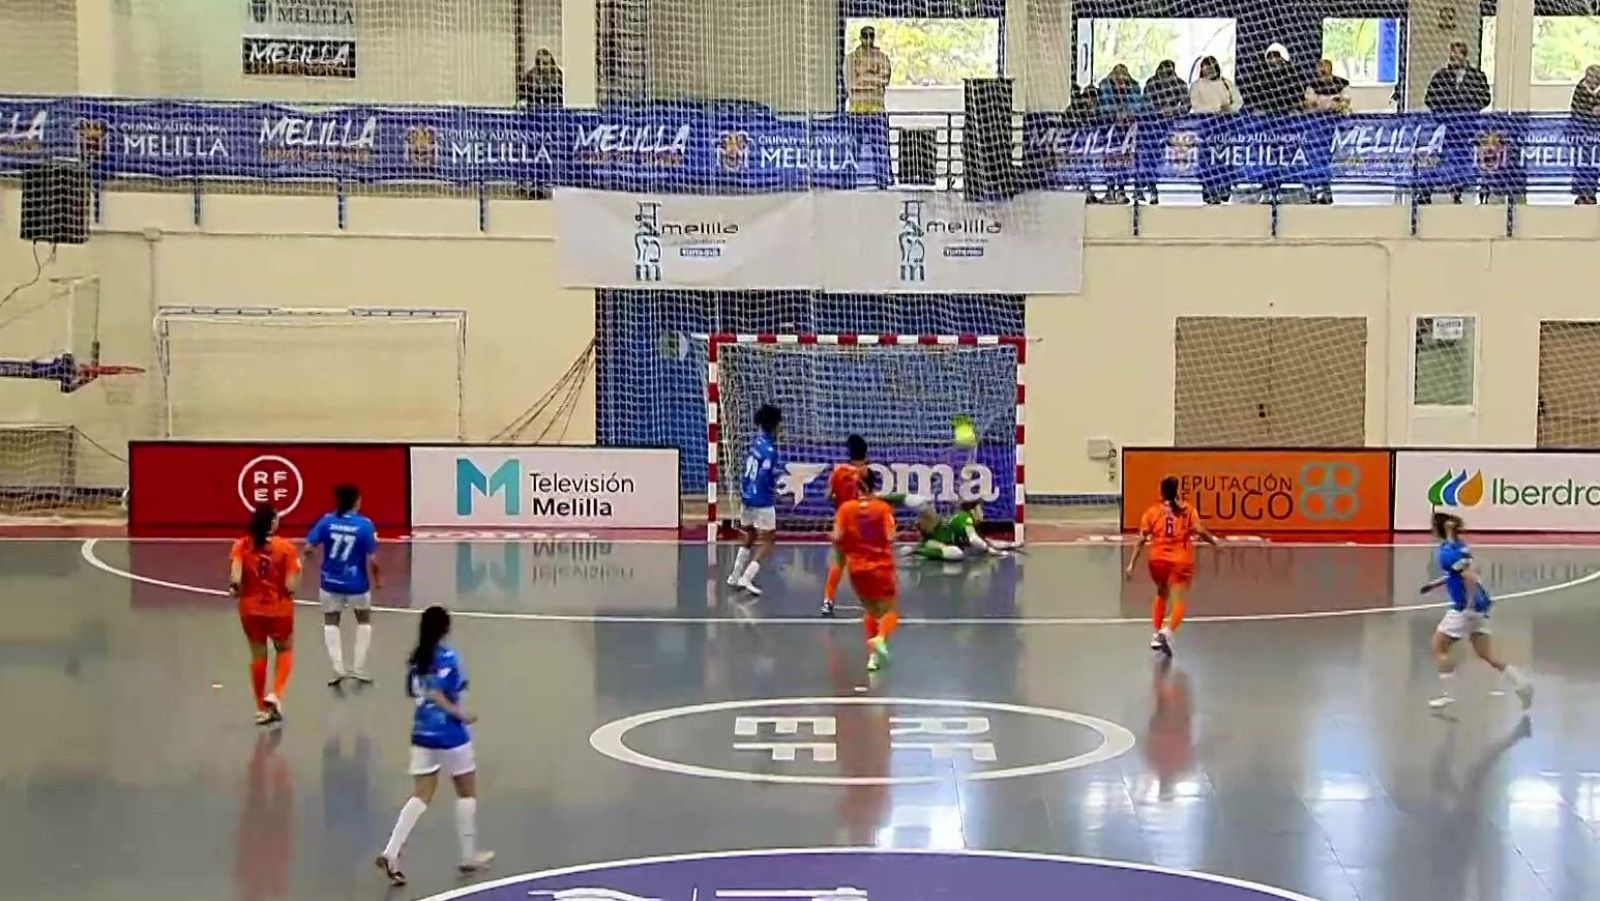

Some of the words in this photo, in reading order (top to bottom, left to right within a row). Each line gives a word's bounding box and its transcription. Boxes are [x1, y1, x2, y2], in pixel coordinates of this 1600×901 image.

[278, 7, 354, 24] MELILLA
[249, 42, 350, 66] MELILLA
[258, 115, 377, 147] MELILLA
[573, 123, 691, 153] MELILLA
[1328, 123, 1447, 155] MELILLA
[123, 135, 229, 157] MELILLA
[451, 142, 553, 164] MELILLA
[1210, 145, 1309, 166] MELILLA
[760, 147, 859, 170] MELILLA
[661, 221, 740, 236] melilla
[926, 218, 1002, 234] melilla
[529, 472, 635, 493] Televisión
[864, 462, 1000, 501] oma
[1181, 474, 1293, 492] EPUTACIÓN
[532, 498, 613, 517] Melilla
[1195, 489, 1294, 520] LUGO
[328, 531, 357, 561] 77
